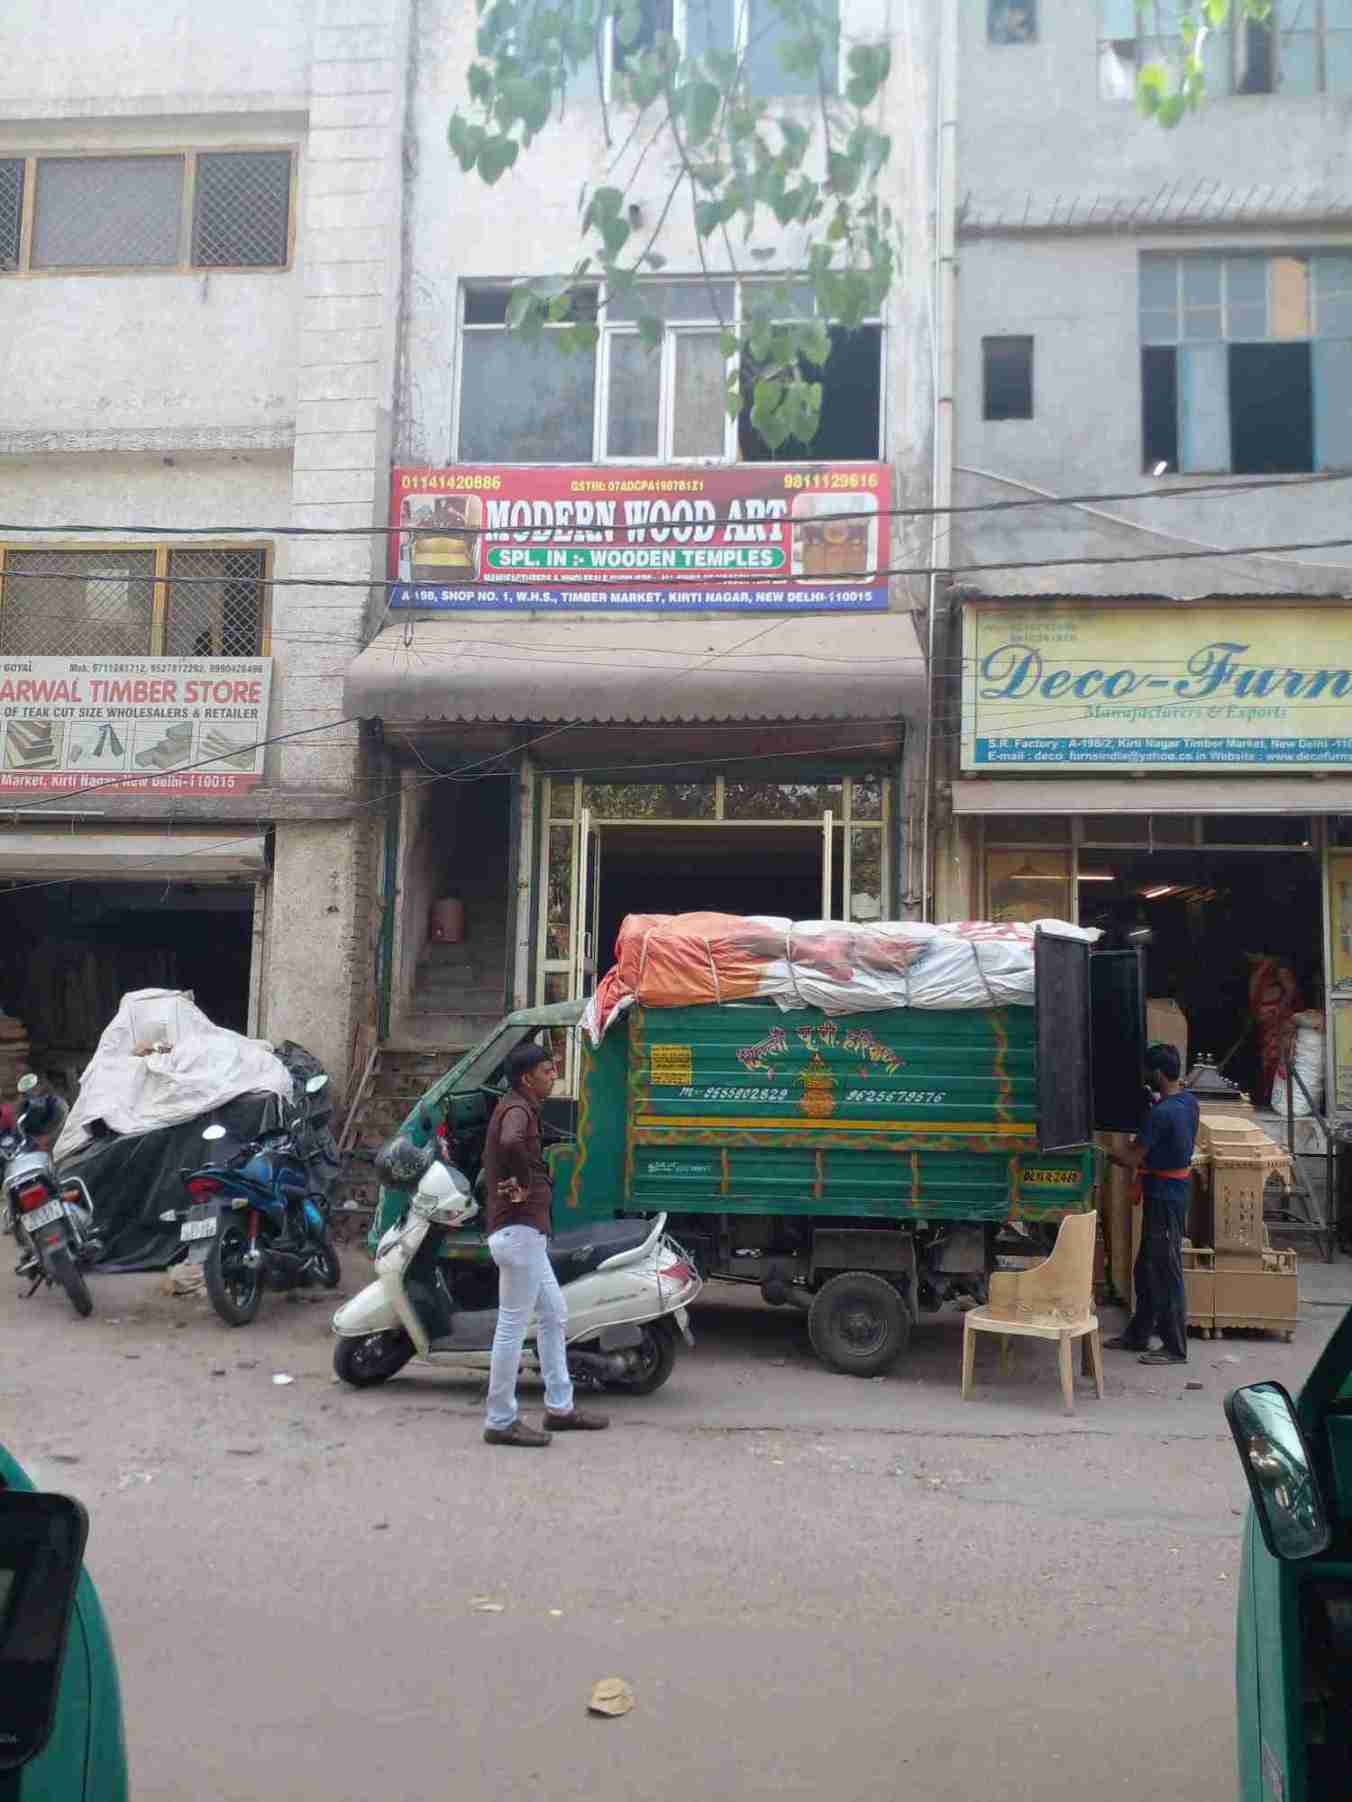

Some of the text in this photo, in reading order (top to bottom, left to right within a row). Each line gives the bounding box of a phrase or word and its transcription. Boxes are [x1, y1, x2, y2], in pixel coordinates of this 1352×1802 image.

[485, 498, 787, 542] MODERN WOOD ART
[499, 551, 541, 567] SPL.
[546, 551, 567, 566] IN
[591, 550, 676, 566] WOODEN
[683, 549, 773, 566] TEMPLES
[441, 591, 475, 601] SHOP
[478, 591, 499, 601] NO.
[560, 591, 607, 602] TIMBER
[610, 591, 665, 604] MARKET,
[705, 591, 752, 603] NAGAR,
[755, 591, 784, 601] NEW
[89, 679, 178, 704] TIMBER
[183, 679, 262, 704] STORE
[4, 707, 17, 718] OF
[23, 707, 49, 718] TEAK
[53, 707, 76, 718] CUT
[79, 707, 104, 718] SIZE
[107, 707, 189, 719] WHOLESALERS
[204, 708, 259, 719] RETAILER
